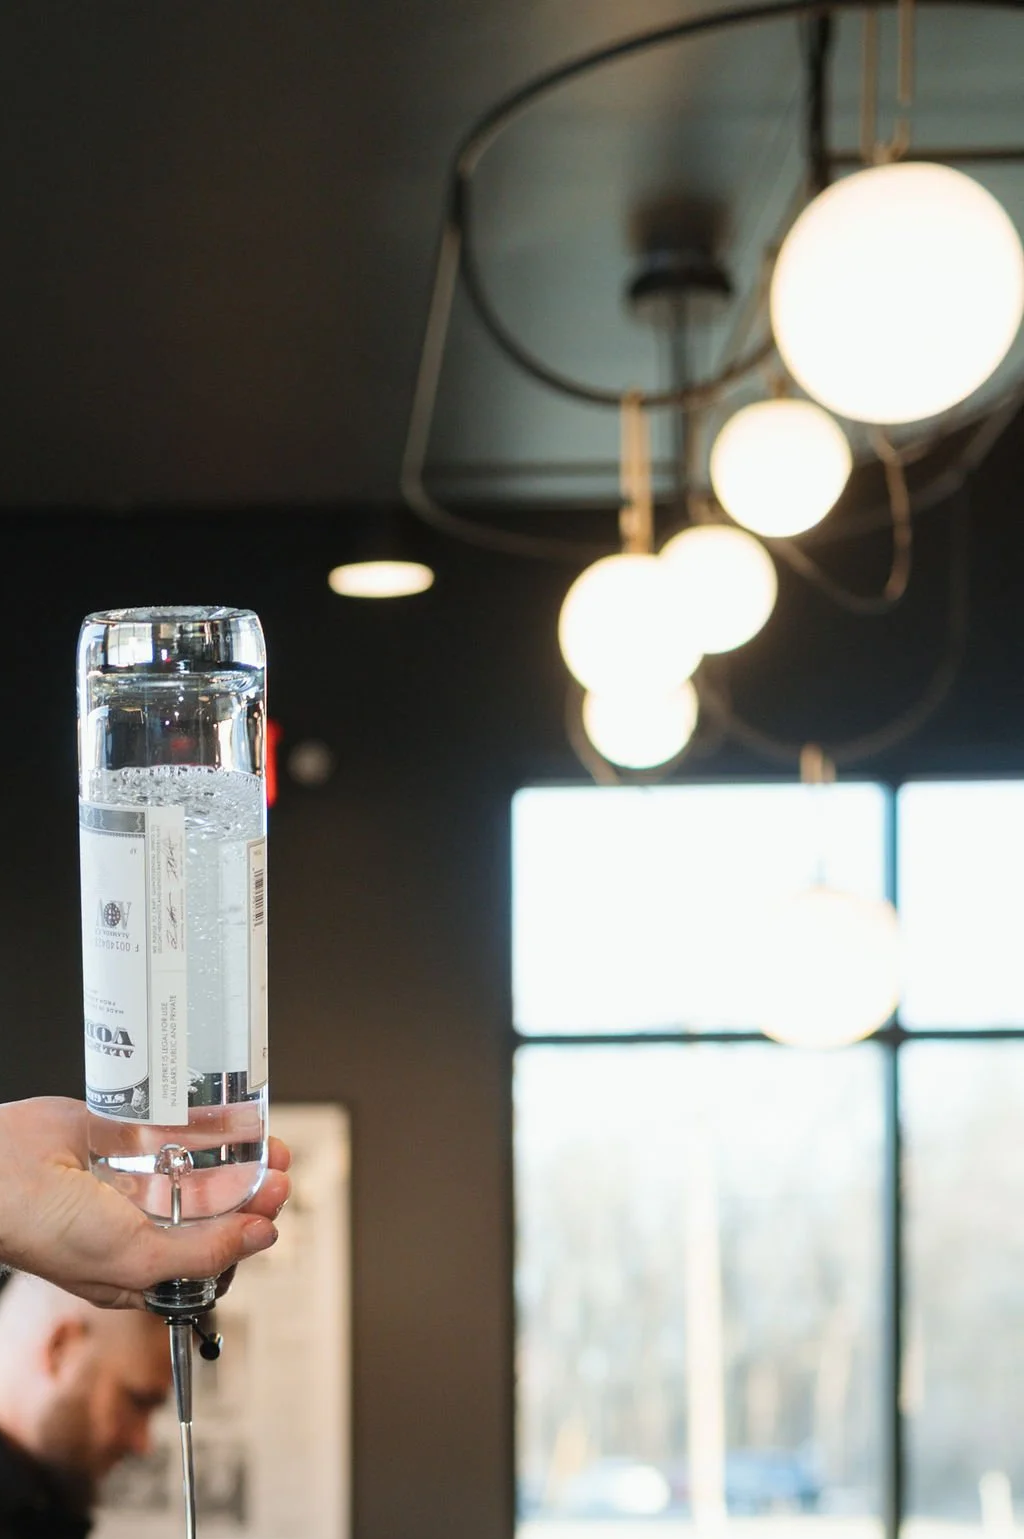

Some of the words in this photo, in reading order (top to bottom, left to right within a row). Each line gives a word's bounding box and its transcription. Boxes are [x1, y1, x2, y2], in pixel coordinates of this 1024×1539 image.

[160, 1002, 168, 1016] USE
[169, 994, 177, 1021] PRIVATE
[160, 1018, 168, 1032] FOR
[169, 1022, 177, 1040] AND
[169, 1041, 177, 1064] PUBLIC
[169, 1085, 177, 1098] ALL
[169, 1098, 177, 1107] IN
